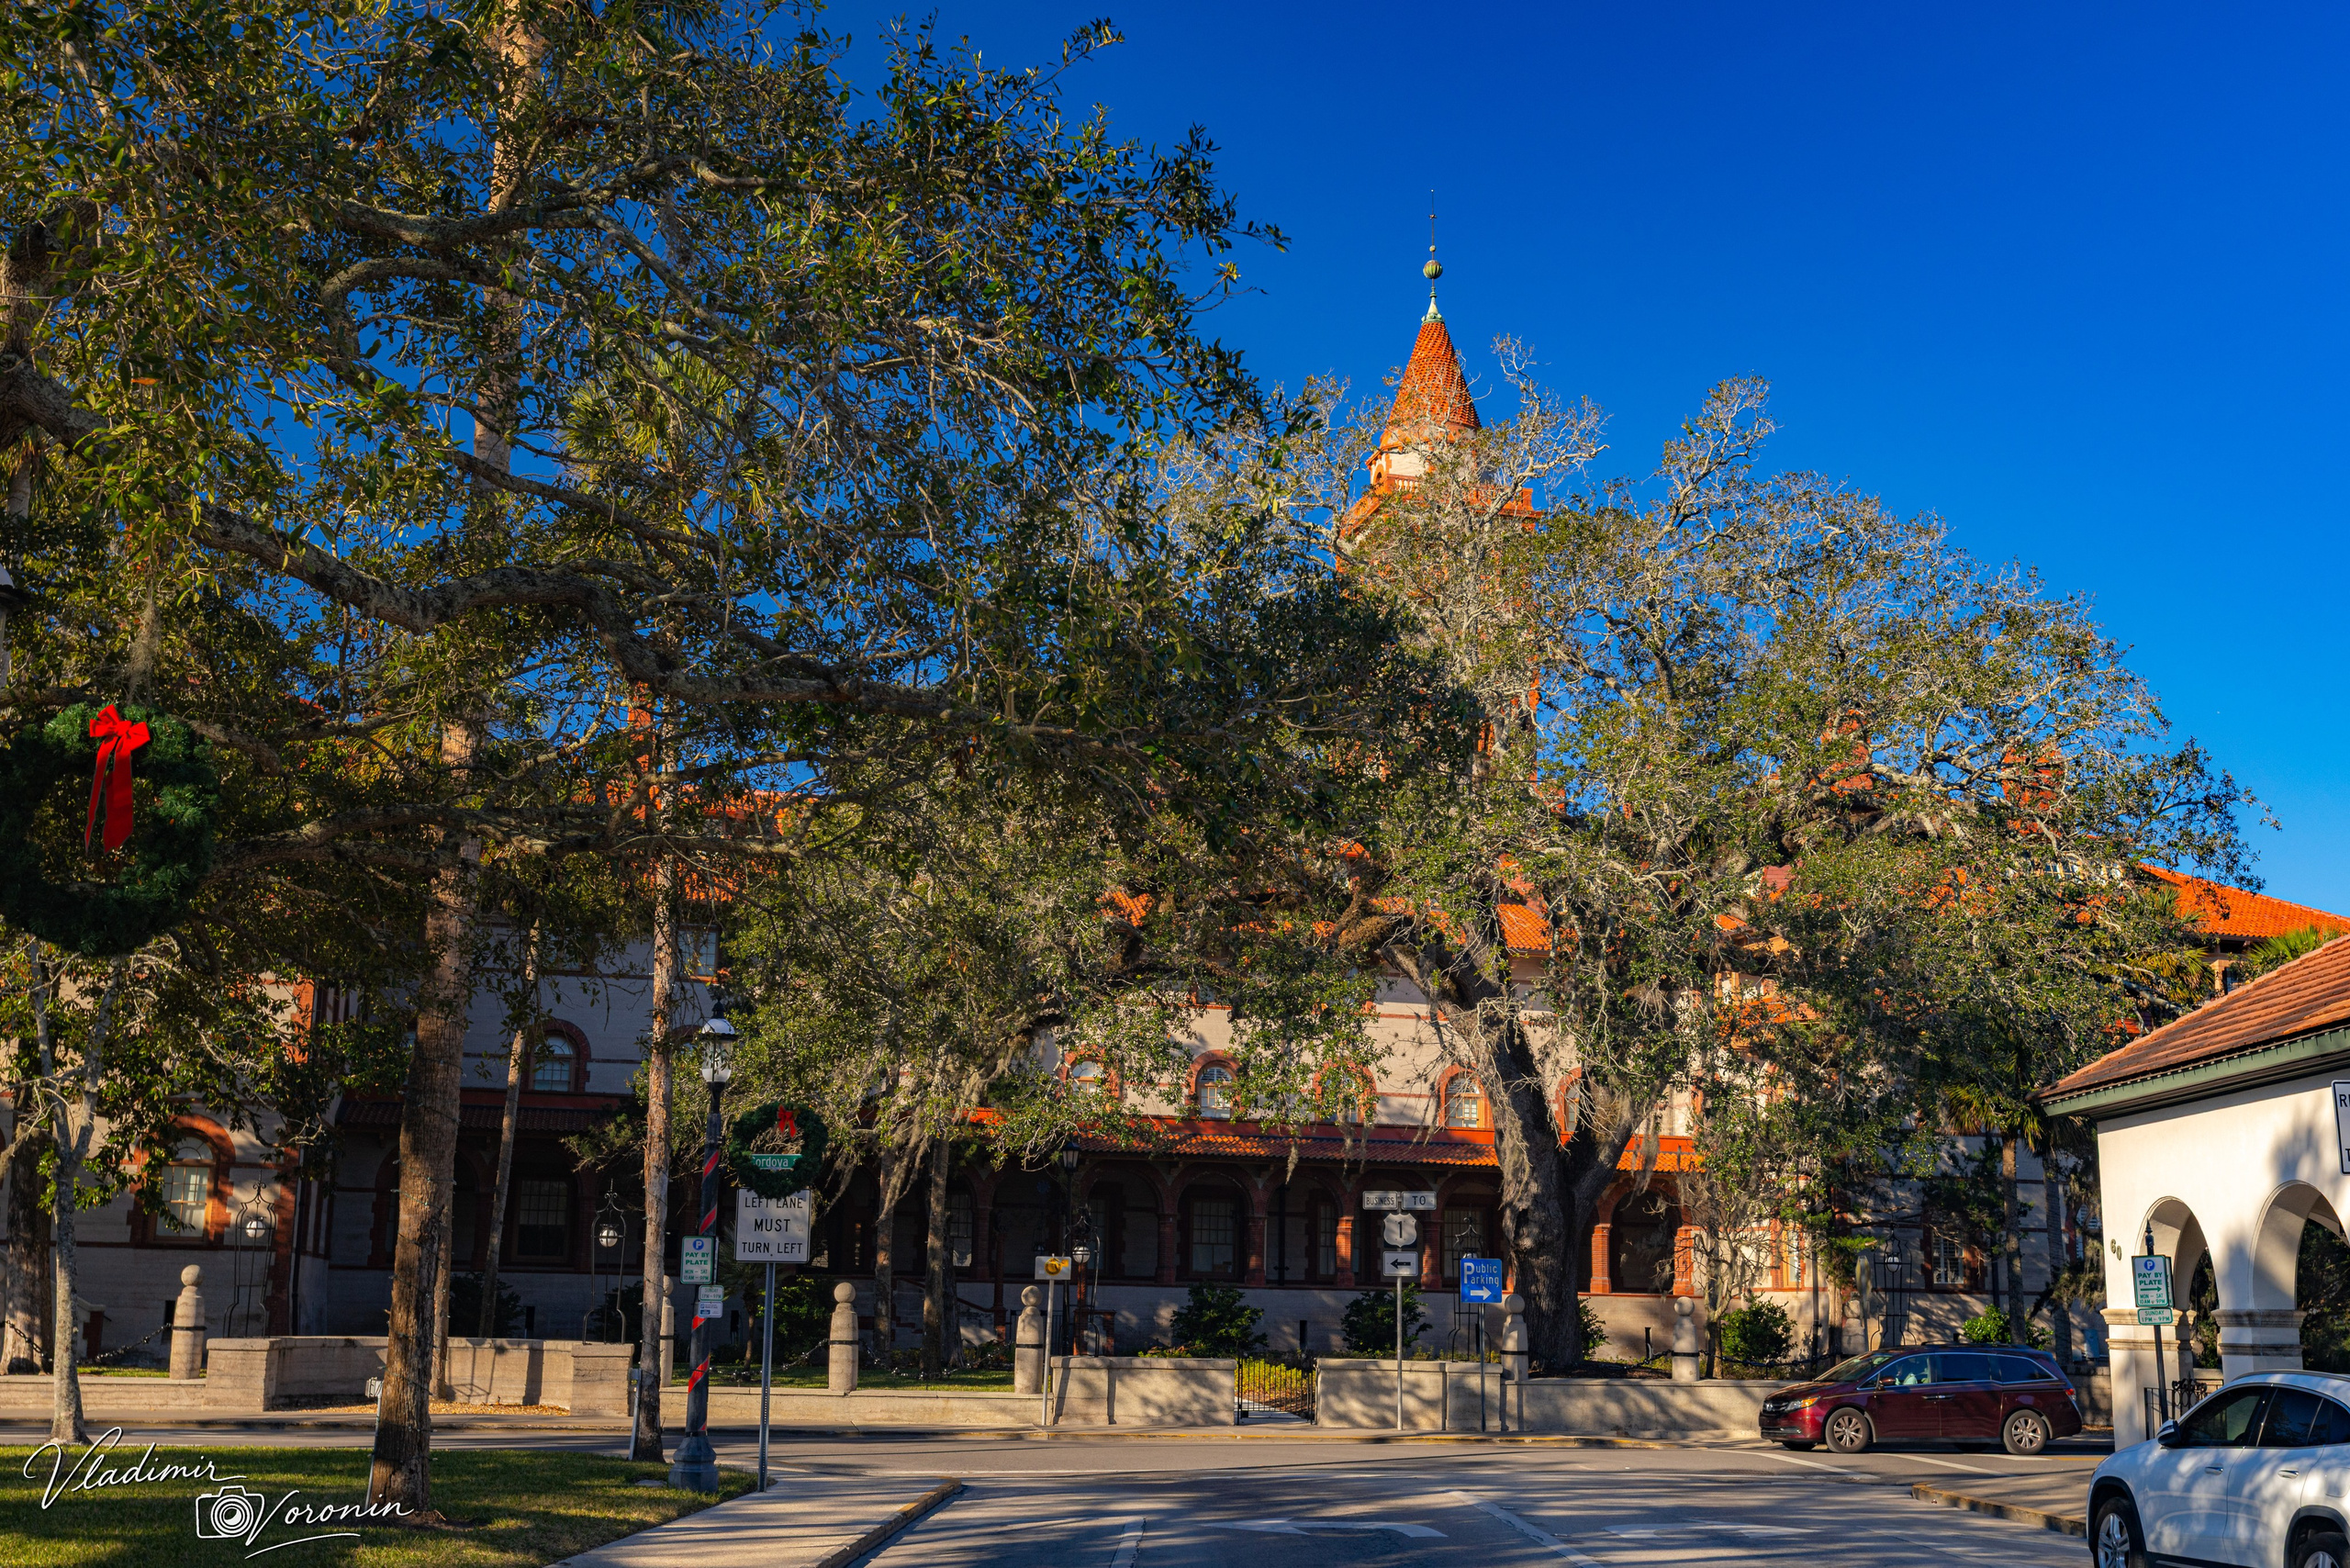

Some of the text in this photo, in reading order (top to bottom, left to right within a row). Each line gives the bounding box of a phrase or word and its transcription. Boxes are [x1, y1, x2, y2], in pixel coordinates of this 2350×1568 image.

[752, 1157, 789, 1167] ordova
[744, 1197, 803, 1208] LEFT LANE
[1366, 1197, 1394, 1205] BUSINESS
[1412, 1195, 1426, 1205] TO
[754, 1218, 790, 1232] MUST
[1397, 1221, 1403, 1238] 1
[742, 1242, 803, 1254] TURN LEFT
[2110, 1238, 2122, 1260] 60
[1463, 1262, 1497, 1284] Public
